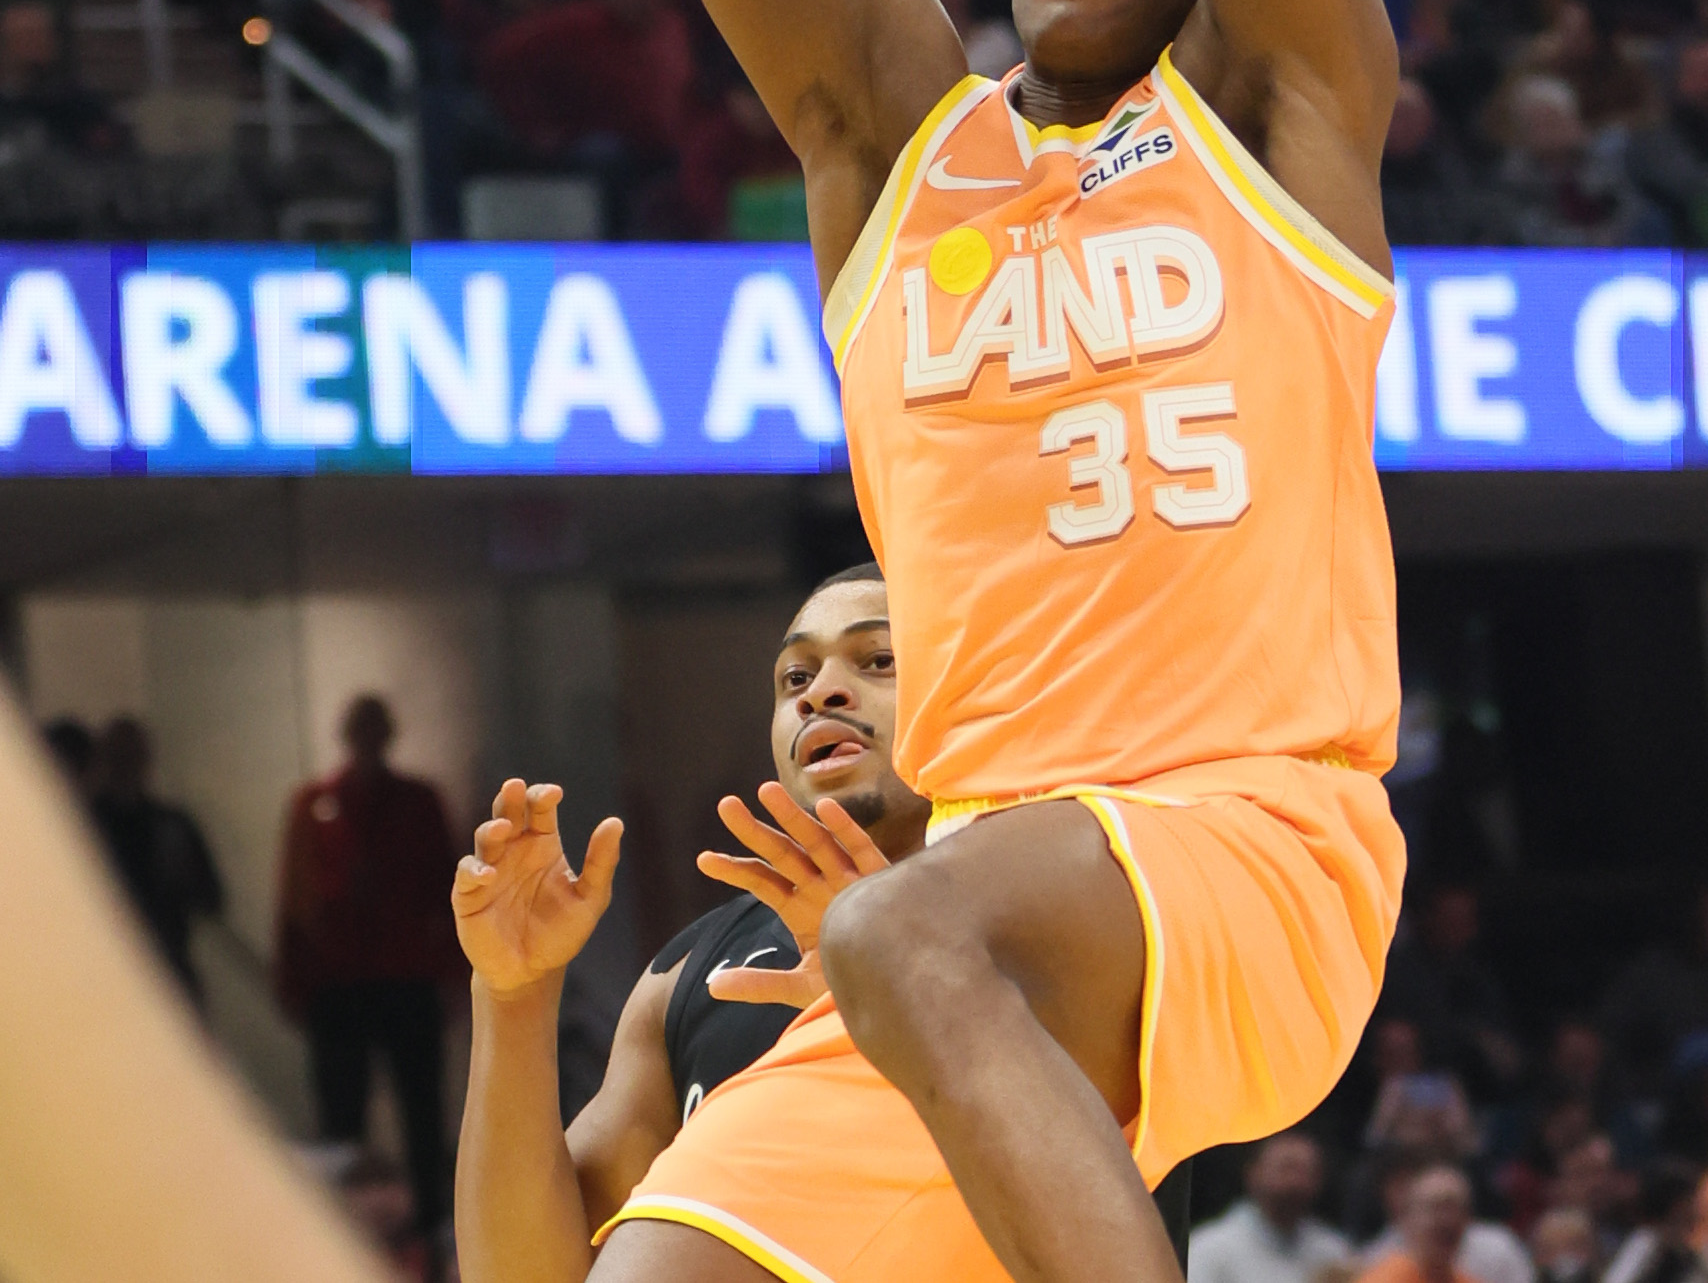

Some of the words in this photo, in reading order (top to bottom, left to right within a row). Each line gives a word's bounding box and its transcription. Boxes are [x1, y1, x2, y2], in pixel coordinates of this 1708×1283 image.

[1006, 214, 1059, 253] THE
[1081, 134, 1173, 193] CLIFFS
[0, 271, 663, 448] ARENA
[903, 225, 1226, 409] LAND
[1039, 380, 1252, 550] 35
